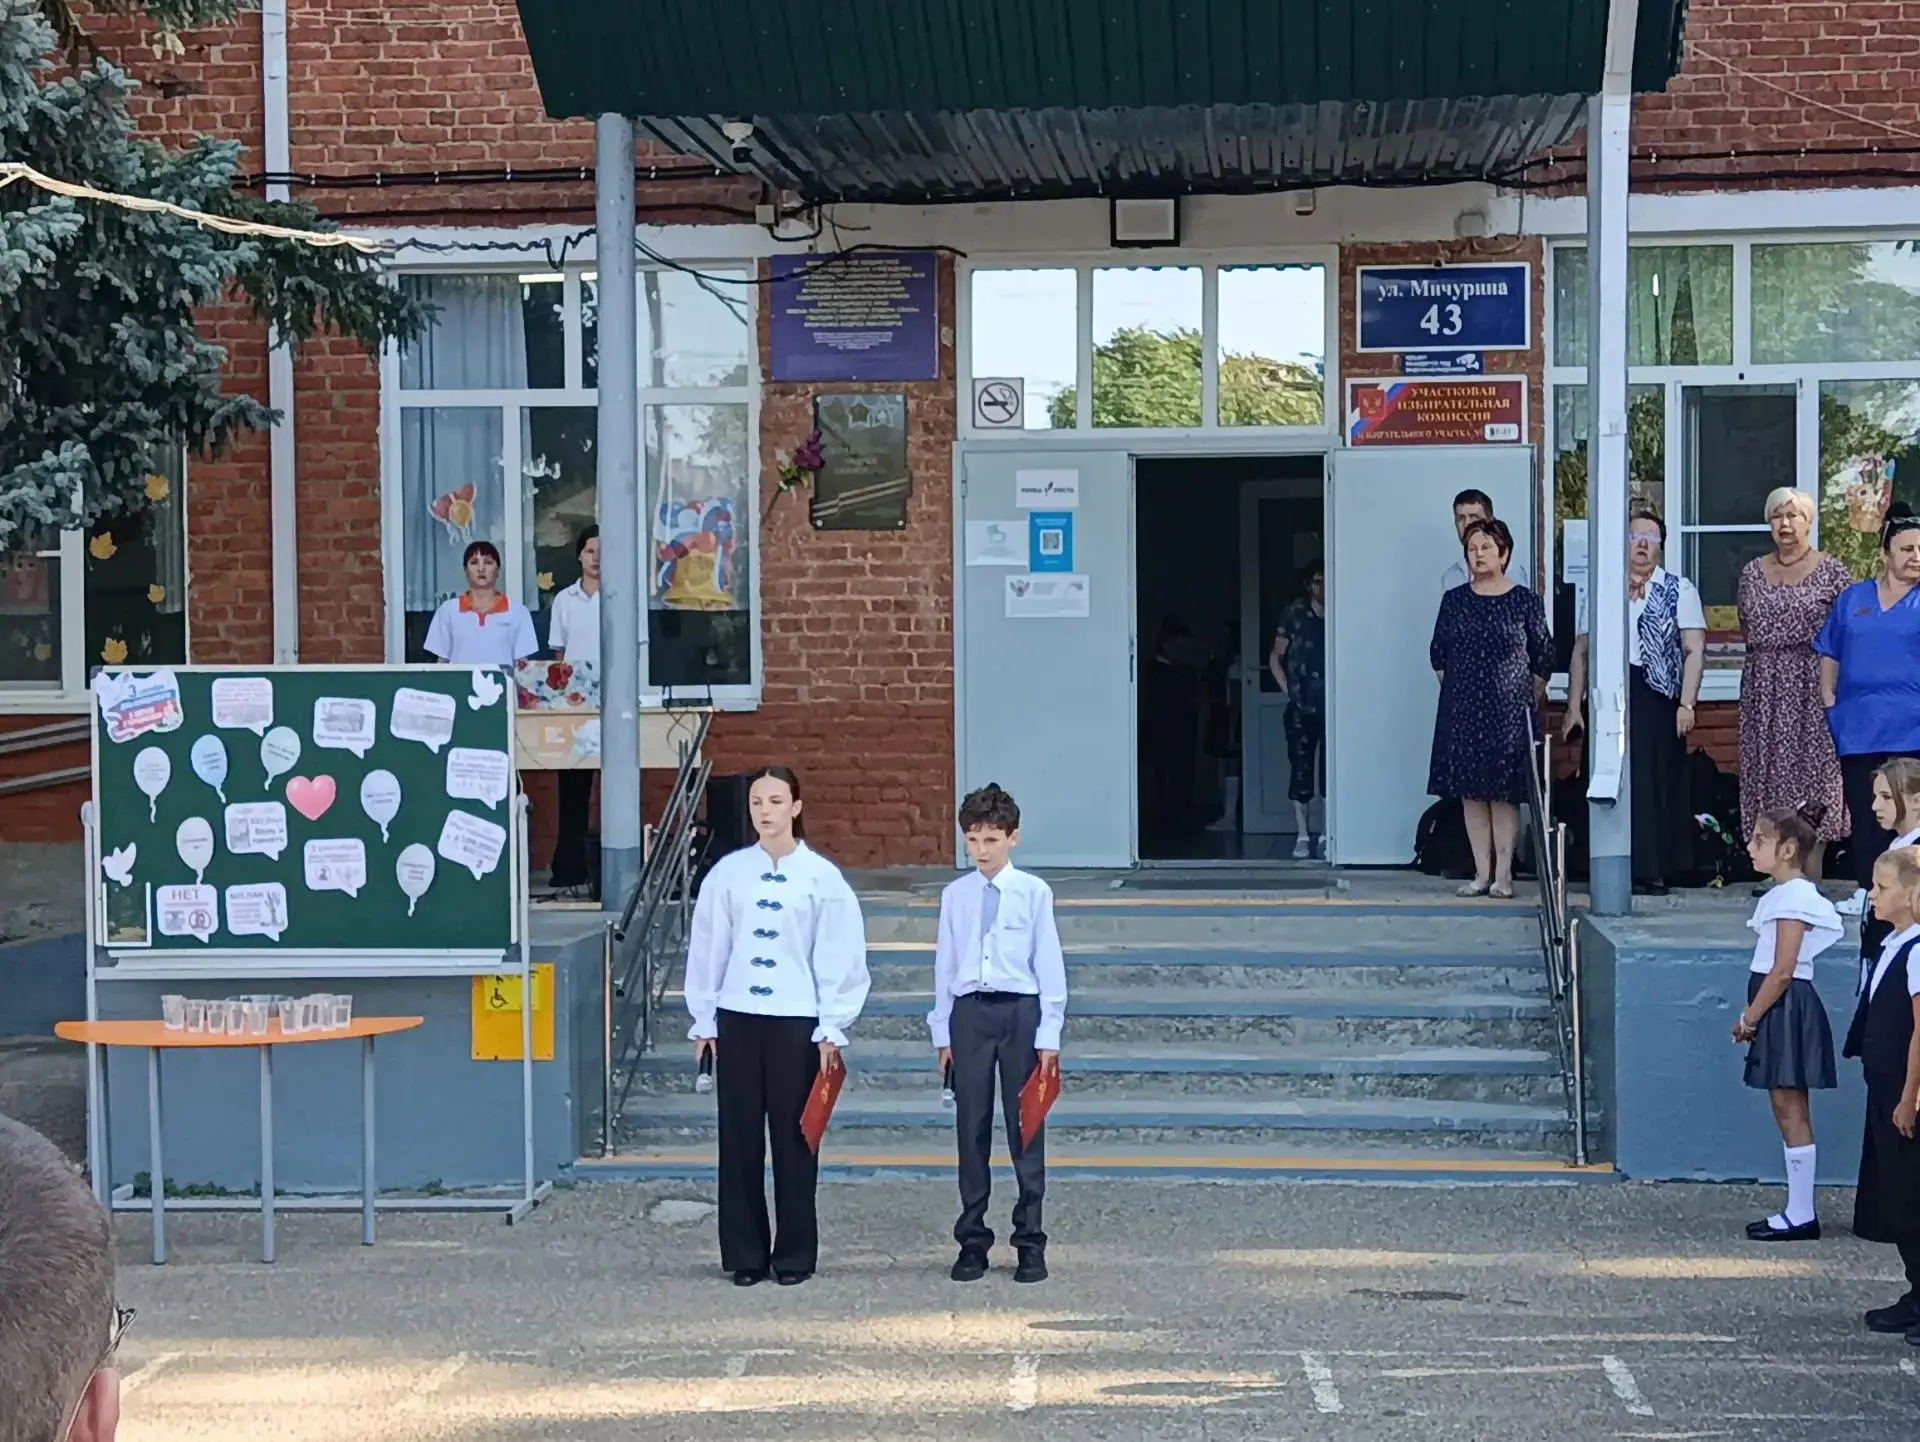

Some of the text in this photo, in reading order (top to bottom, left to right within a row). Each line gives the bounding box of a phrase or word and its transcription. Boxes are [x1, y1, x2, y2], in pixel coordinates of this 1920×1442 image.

[1378, 280, 1508, 302] ул. Мичурина
[1420, 303, 1463, 335] 43
[1411, 386, 1497, 398] УЧАСТКОВАЯ
[1397, 398, 1511, 411] ИЗБИРАТЕЛЬНАЯ
[171, 888, 201, 901] НЕТ
